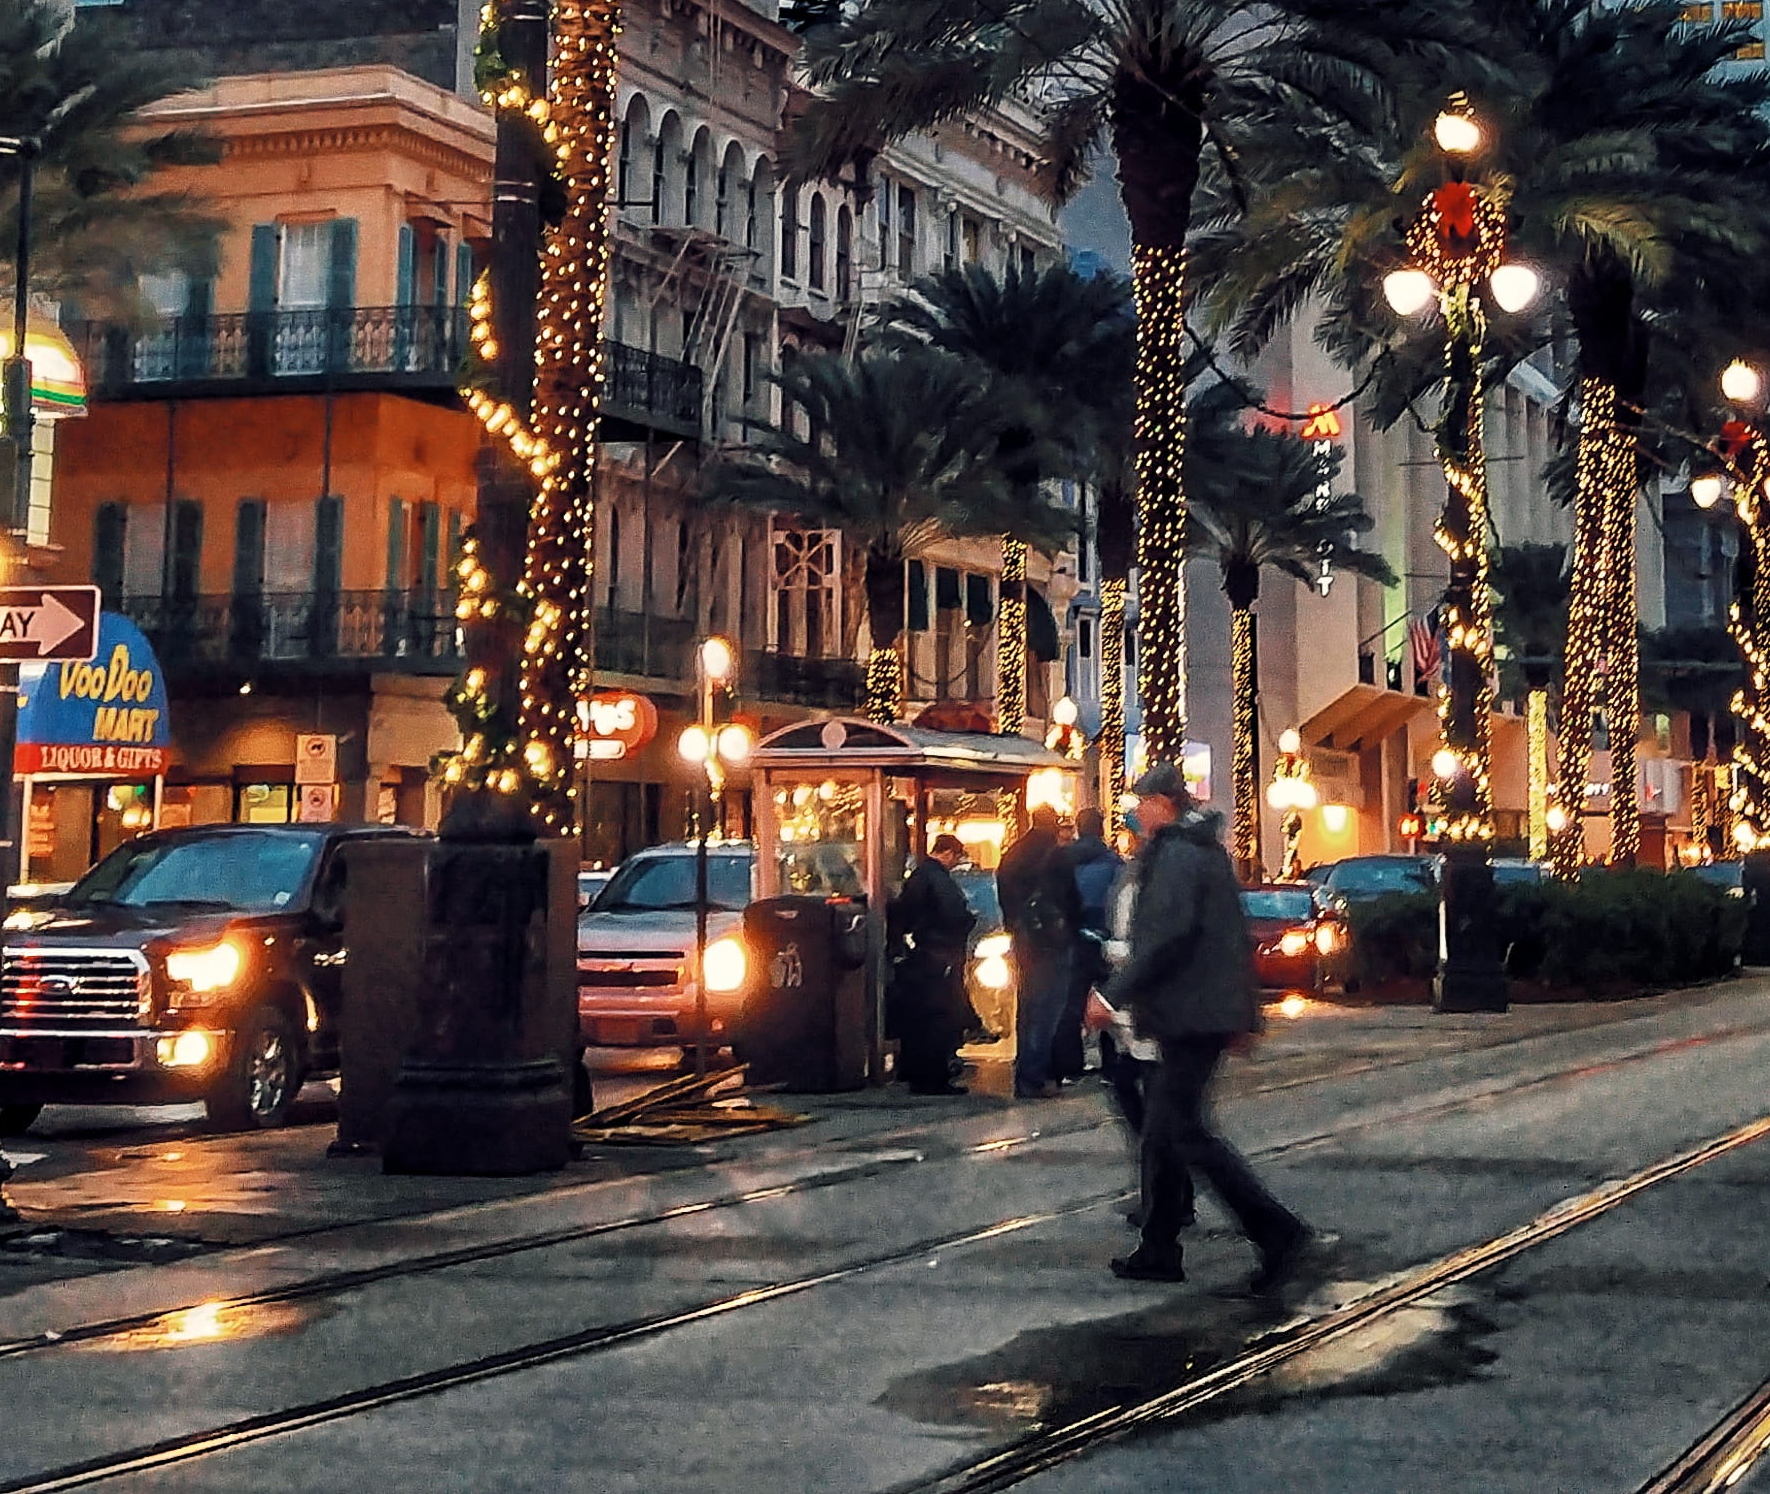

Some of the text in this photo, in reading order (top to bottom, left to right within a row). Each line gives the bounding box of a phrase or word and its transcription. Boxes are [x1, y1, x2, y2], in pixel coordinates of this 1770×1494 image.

[92, 706, 160, 743] MART
[41, 745, 103, 772] LIQUOR
[116, 746, 163, 770] GIFTS
